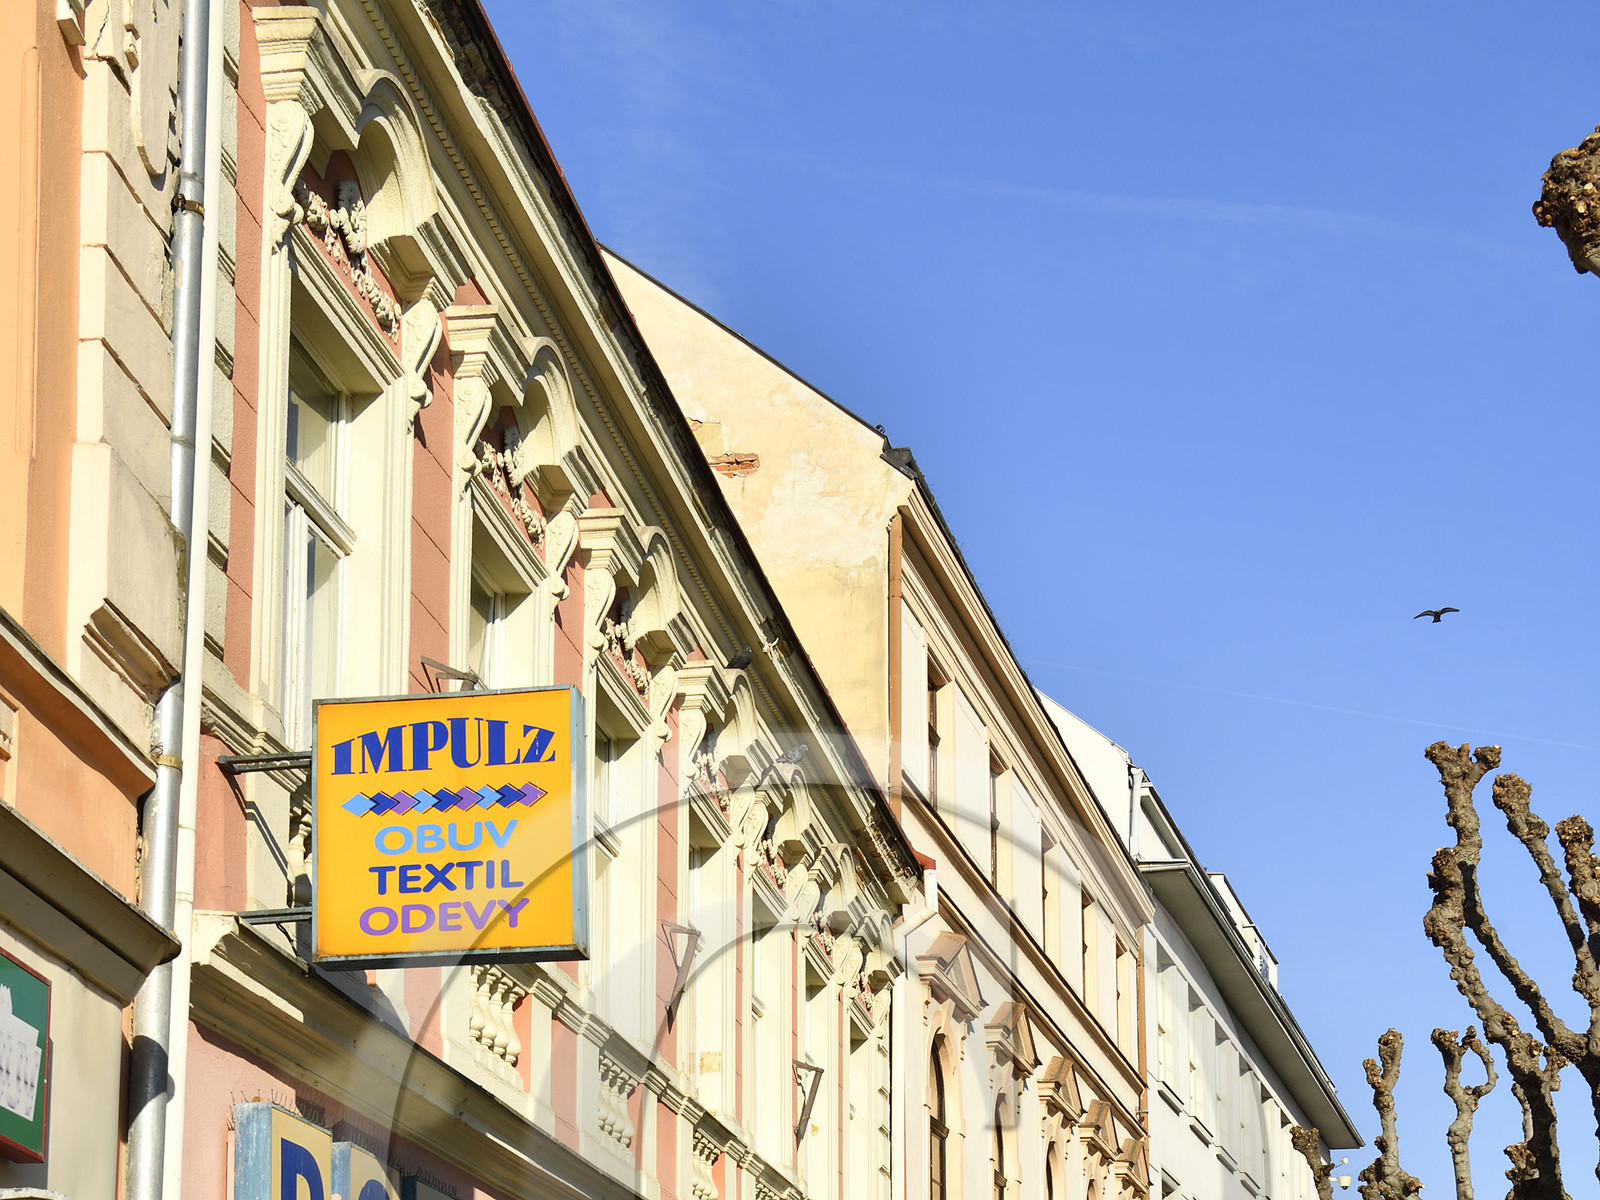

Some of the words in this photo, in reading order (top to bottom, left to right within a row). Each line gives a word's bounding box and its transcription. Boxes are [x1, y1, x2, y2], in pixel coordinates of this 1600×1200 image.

[331, 717, 556, 776] IMPULZ
[374, 818, 519, 856] OBUV
[368, 859, 525, 896] TEXTIL
[359, 897, 530, 936] ODEVY
